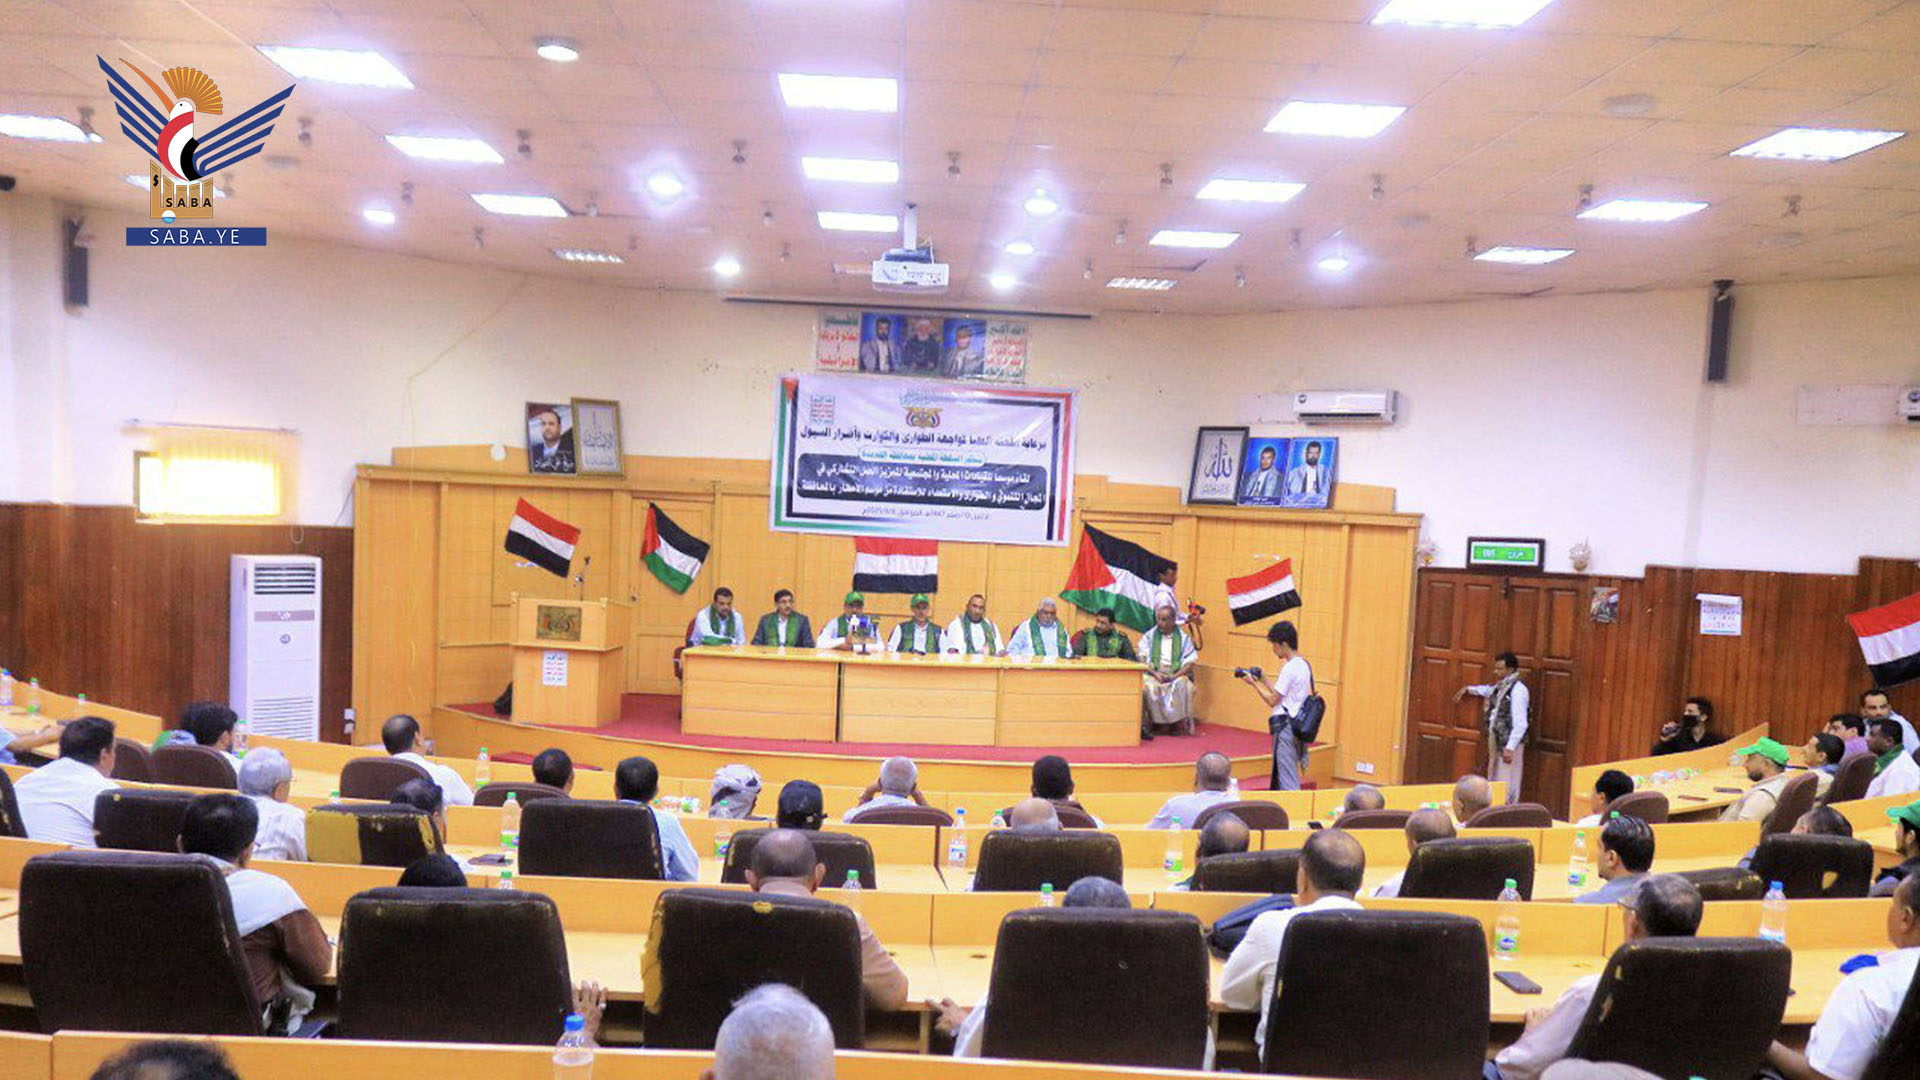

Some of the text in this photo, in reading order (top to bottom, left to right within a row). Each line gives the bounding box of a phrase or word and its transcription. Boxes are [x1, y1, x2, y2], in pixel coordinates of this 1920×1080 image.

[800, 425, 832, 439] السيول
[834, 426, 861, 441] وأضرار
[863, 430, 900, 444] والكوارث
[936, 432, 967, 447] لمواجهة
[1022, 438, 1047, 451] برعاية
[1204, 437, 1233, 481] الله
[816, 462, 826, 477] في
[878, 465, 904, 480] لتعزيز
[905, 465, 940, 481] والمجتمعية
[941, 467, 964, 482] المحلية
[801, 478, 836, 495] بالمحافظة
